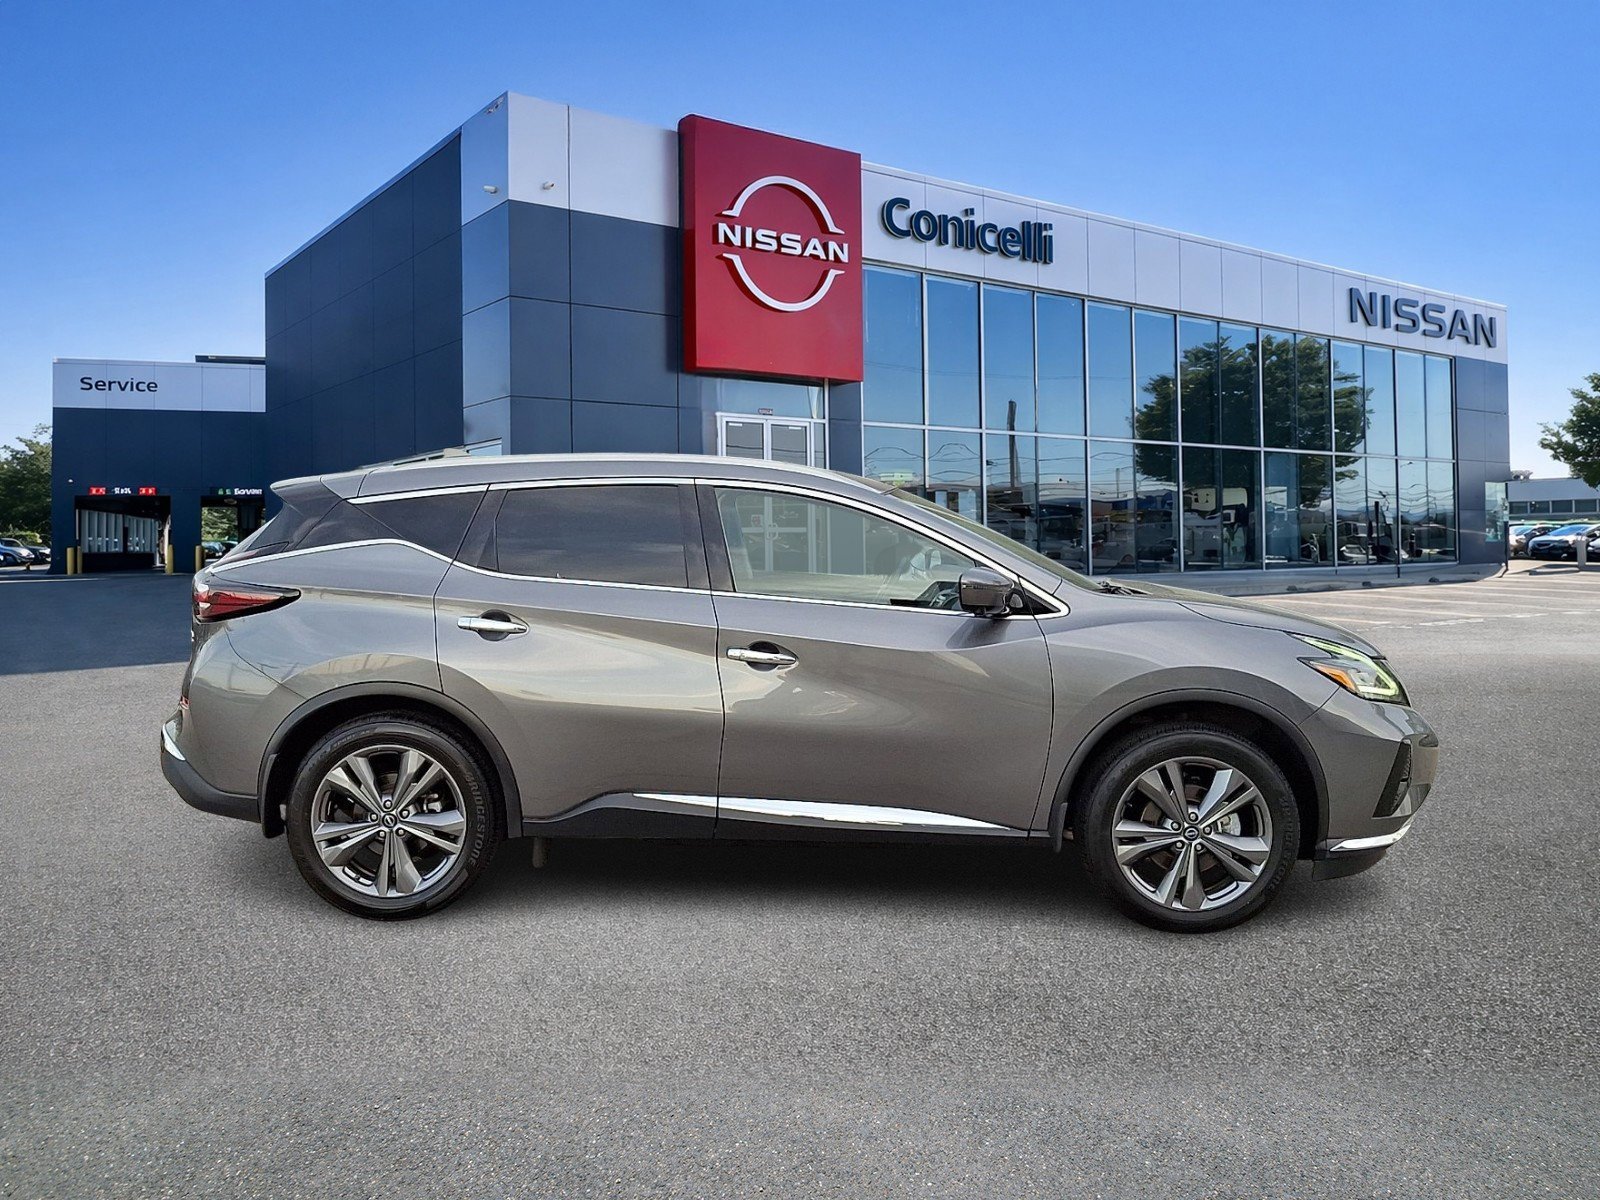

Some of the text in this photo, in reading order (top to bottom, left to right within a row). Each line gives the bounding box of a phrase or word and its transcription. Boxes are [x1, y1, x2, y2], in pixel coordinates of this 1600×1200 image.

[717, 222, 849, 263] NISSAN
[881, 197, 1053, 264] Conicelli
[1348, 287, 1497, 348] NISSAN
[80, 377, 158, 393] Service
